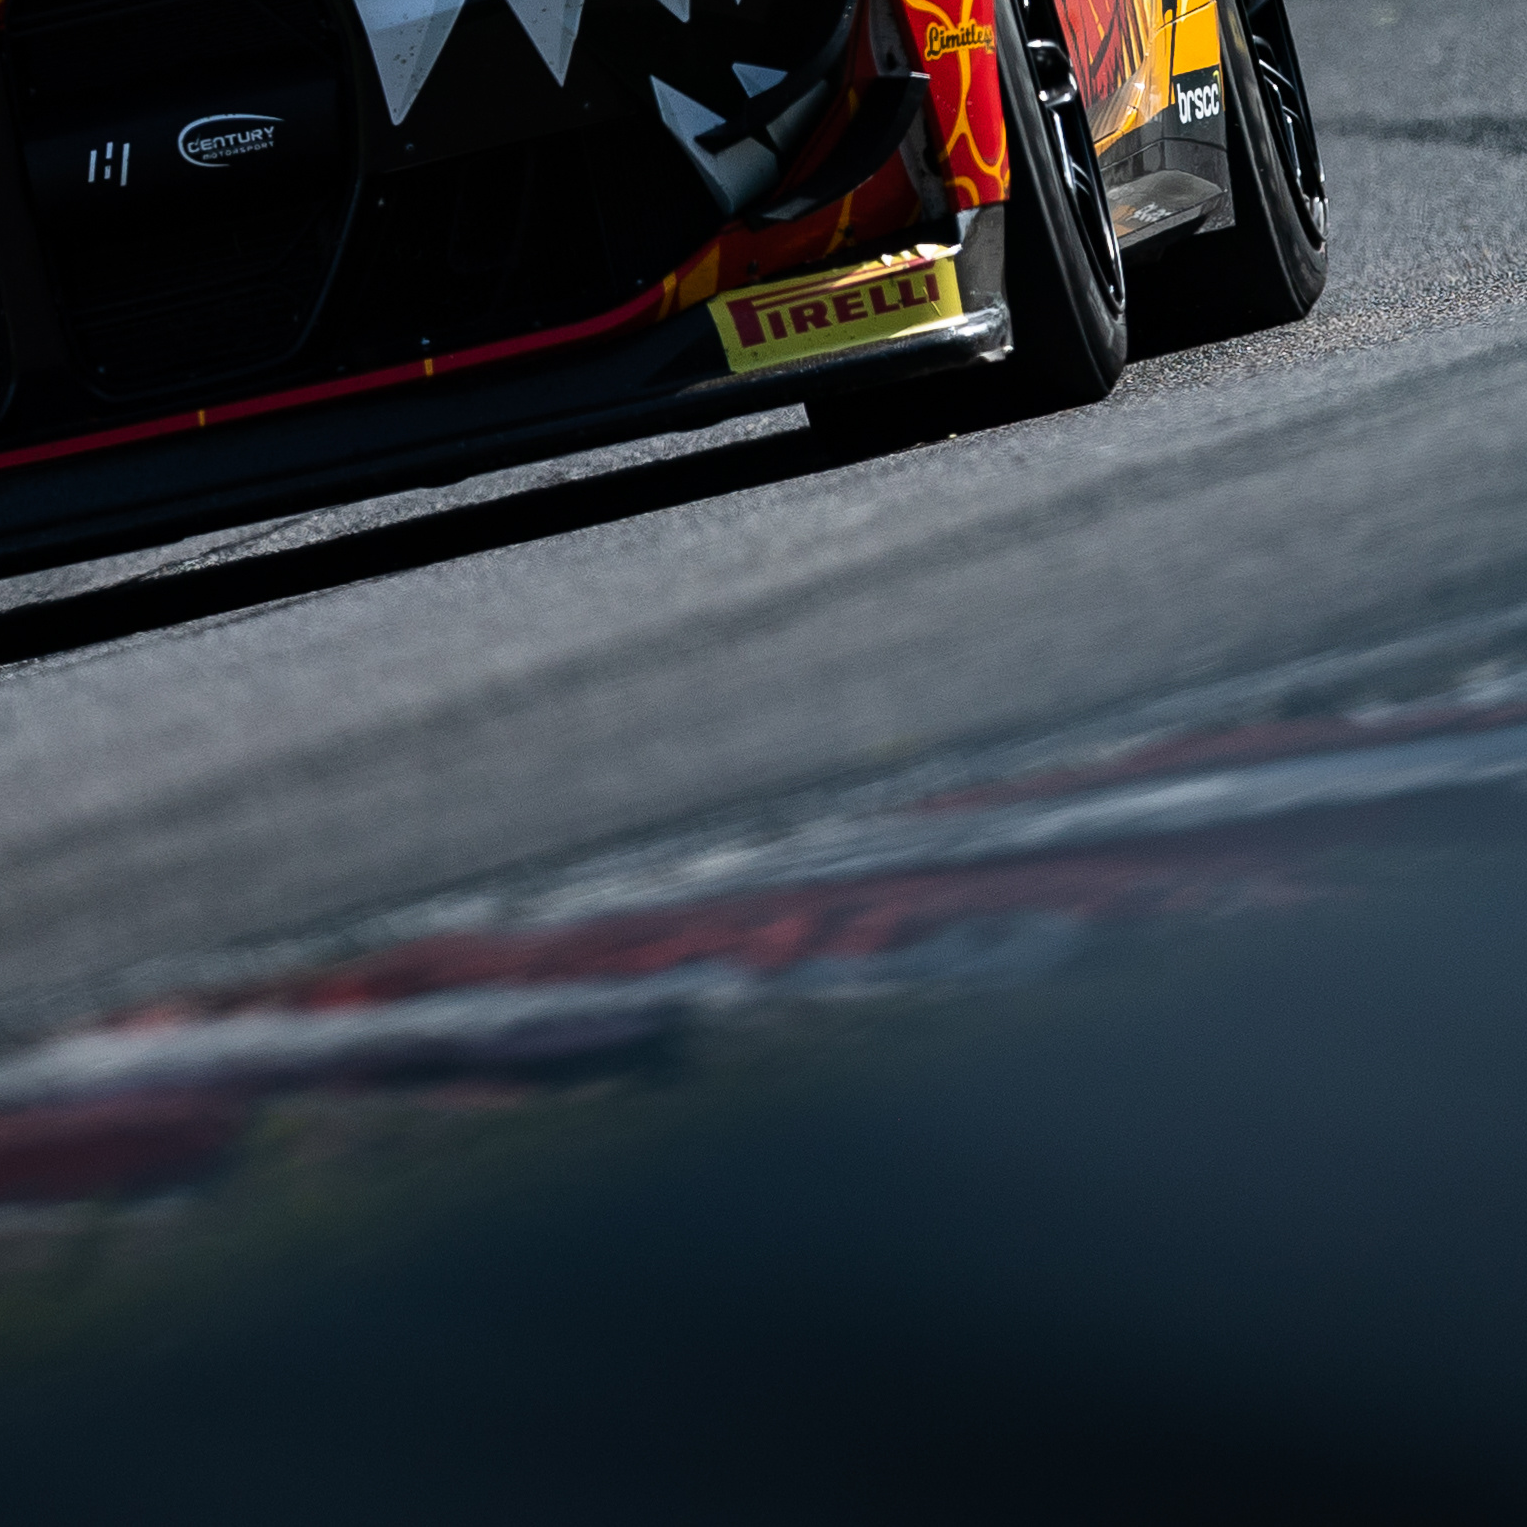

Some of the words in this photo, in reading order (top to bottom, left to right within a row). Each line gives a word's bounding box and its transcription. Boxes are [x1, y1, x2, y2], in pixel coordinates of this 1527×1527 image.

[1176, 82, 1221, 125] brscc
[187, 126, 275, 154] CENTURY
[202, 140, 275, 161] MOTORSPORT
[726, 260, 941, 349] PIRELLI
